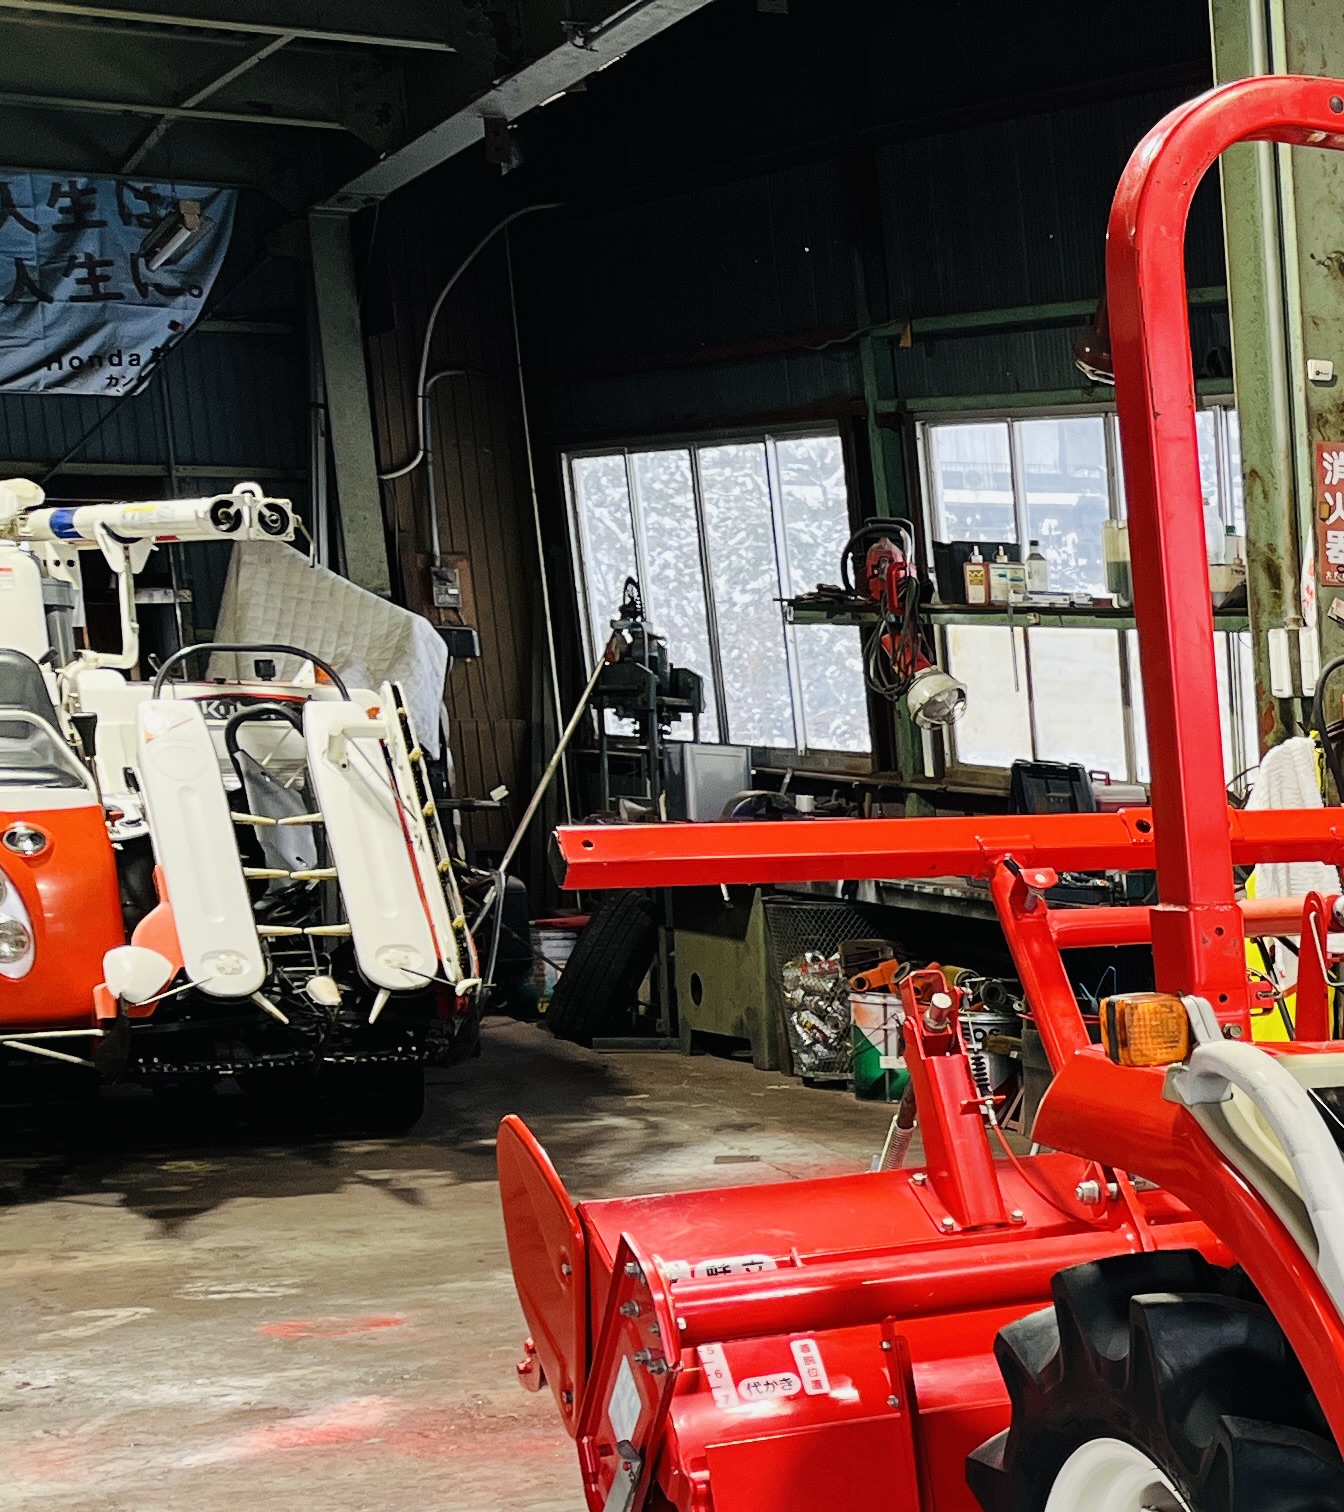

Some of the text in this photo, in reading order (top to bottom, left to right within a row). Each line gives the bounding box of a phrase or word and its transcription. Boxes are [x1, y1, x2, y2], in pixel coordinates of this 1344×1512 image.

[715, 1370, 723, 1378] 6
[746, 1377, 794, 1397] 代かき
